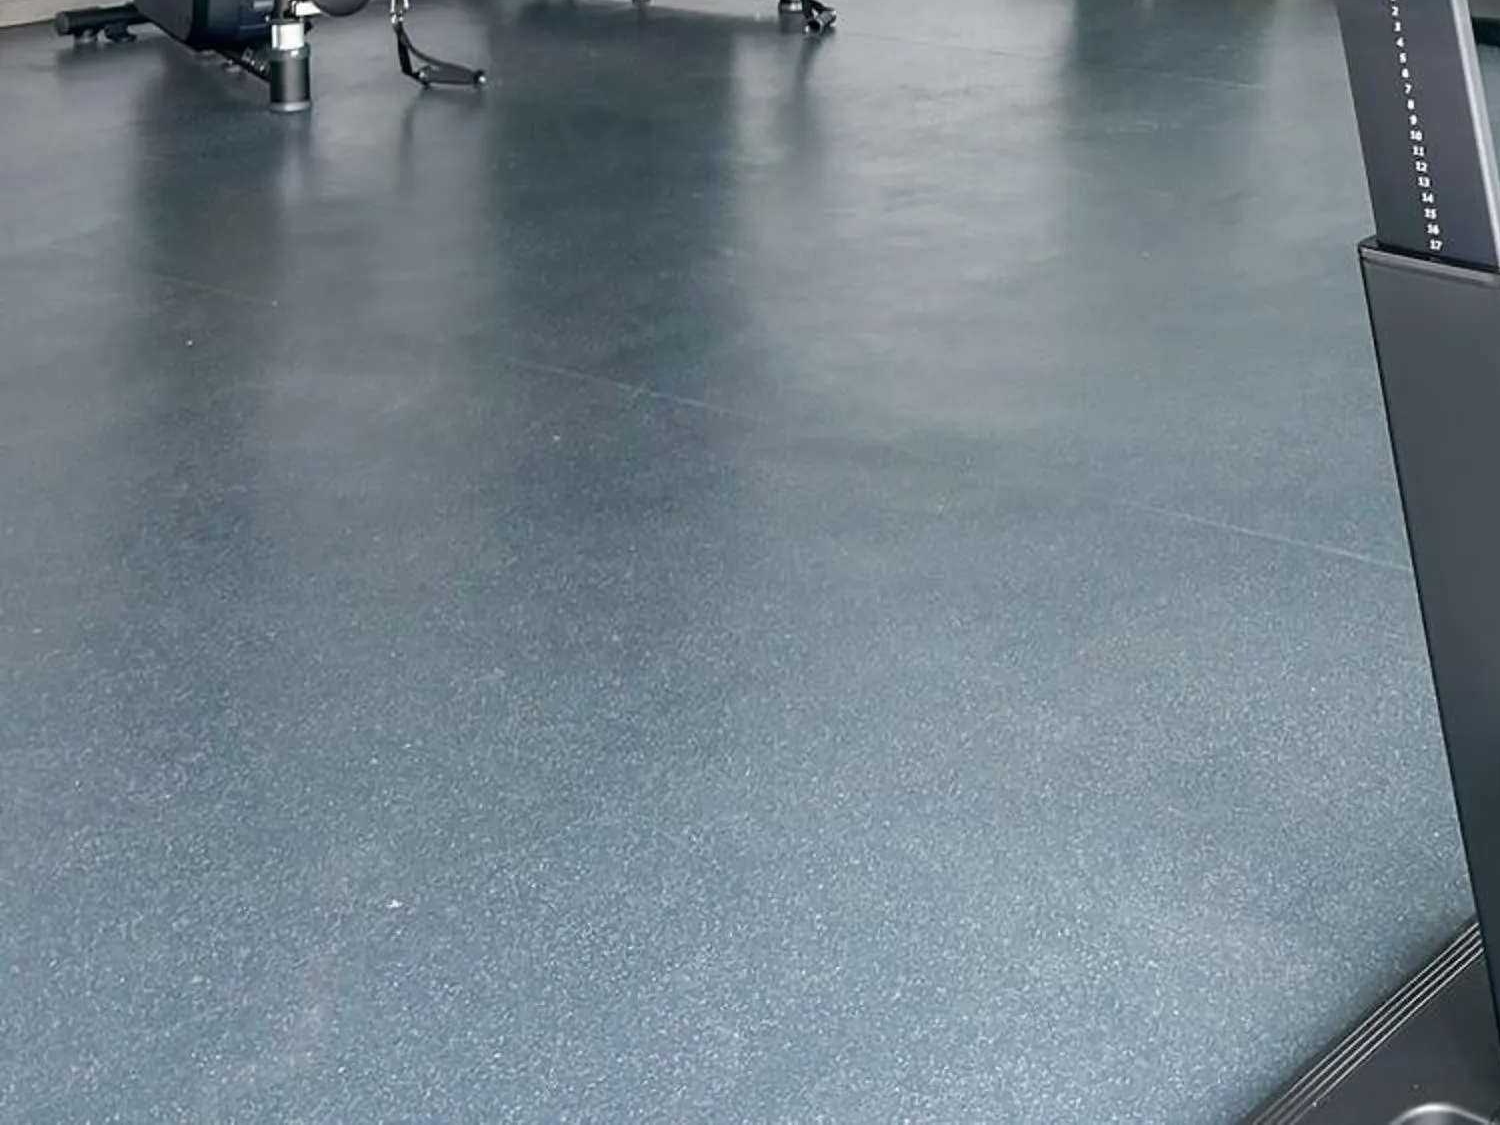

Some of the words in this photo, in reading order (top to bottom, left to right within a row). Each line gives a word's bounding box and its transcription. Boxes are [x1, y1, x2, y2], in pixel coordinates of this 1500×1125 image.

[1391, 5, 1399, 17] 2
[1396, 37, 1405, 48] 4
[1399, 52, 1407, 64] 5
[1405, 83, 1412, 94] 7
[1410, 130, 1423, 142] 10
[1413, 145, 1425, 157] 11
[1415, 160, 1428, 173] 12
[1418, 176, 1430, 188] 13
[1421, 192, 1434, 204] 14
[1424, 208, 1437, 220] 15
[1427, 223, 1440, 235] 16
[1430, 239, 1443, 250] 17
